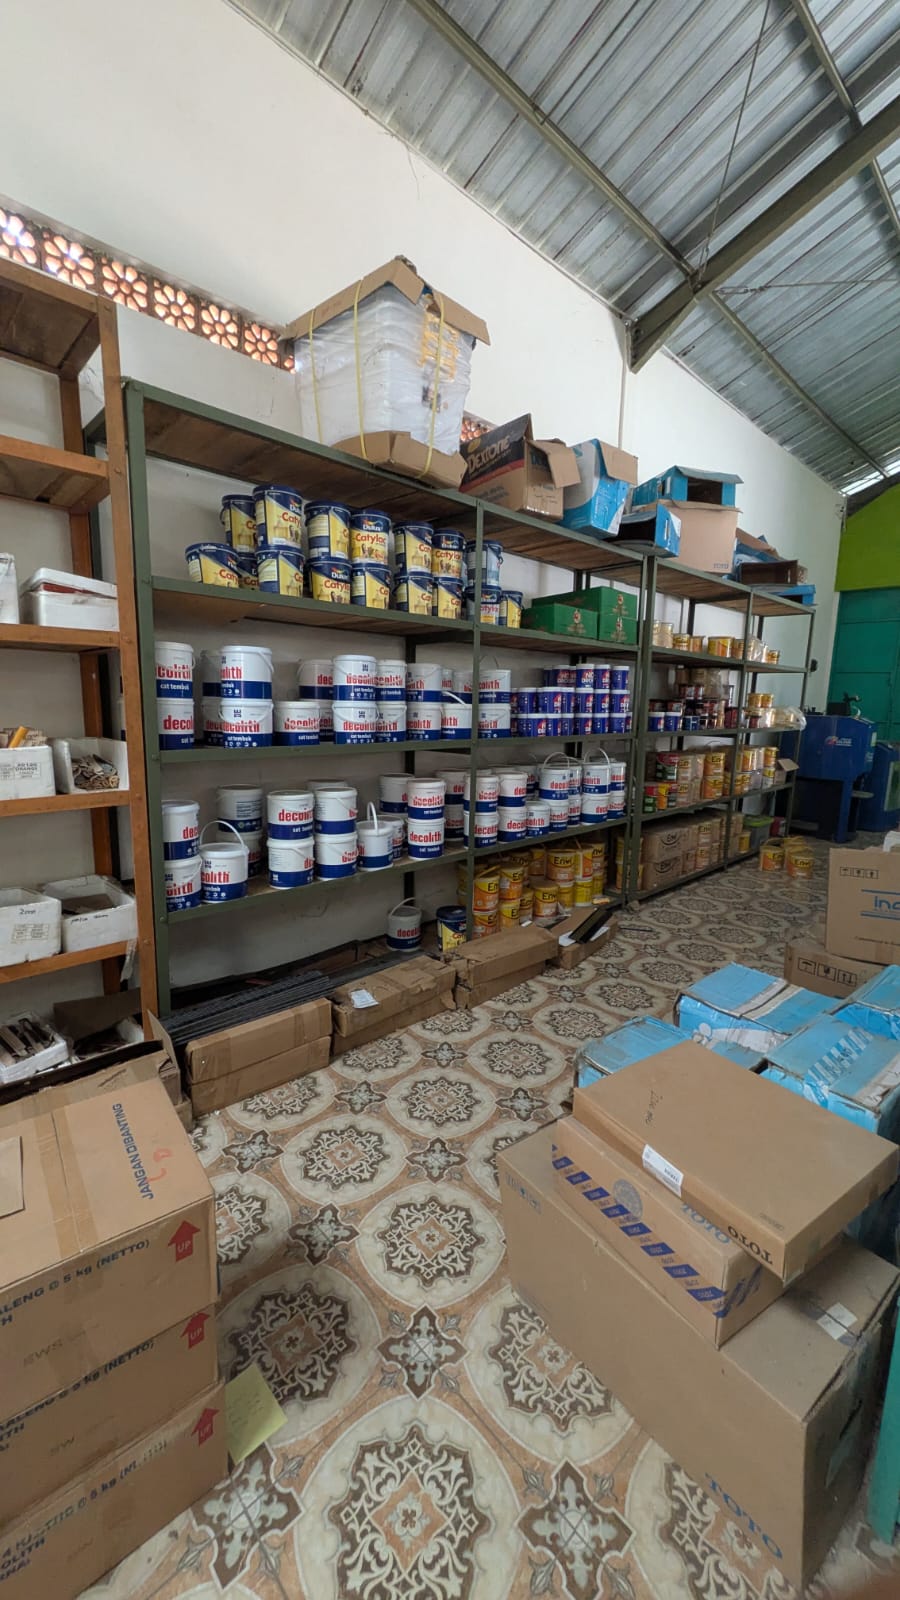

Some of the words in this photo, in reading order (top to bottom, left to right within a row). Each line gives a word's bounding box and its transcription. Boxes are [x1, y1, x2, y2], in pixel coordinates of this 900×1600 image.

[112, 1103, 138, 1153] DIBANTING
[129, 1153, 154, 1200] JANGAN
[681, 1203, 731, 1244] TOTO
[63, 1274, 72, 1284] 5
[76, 1266, 93, 1278] kg
[96, 1239, 150, 1270] (NETTO)
[177, 1240, 191, 1253] UP
[728, 1225, 773, 1265] TOTO
[190, 1327, 202, 1341] UP
[104, 1340, 154, 1375] (NETTO)
